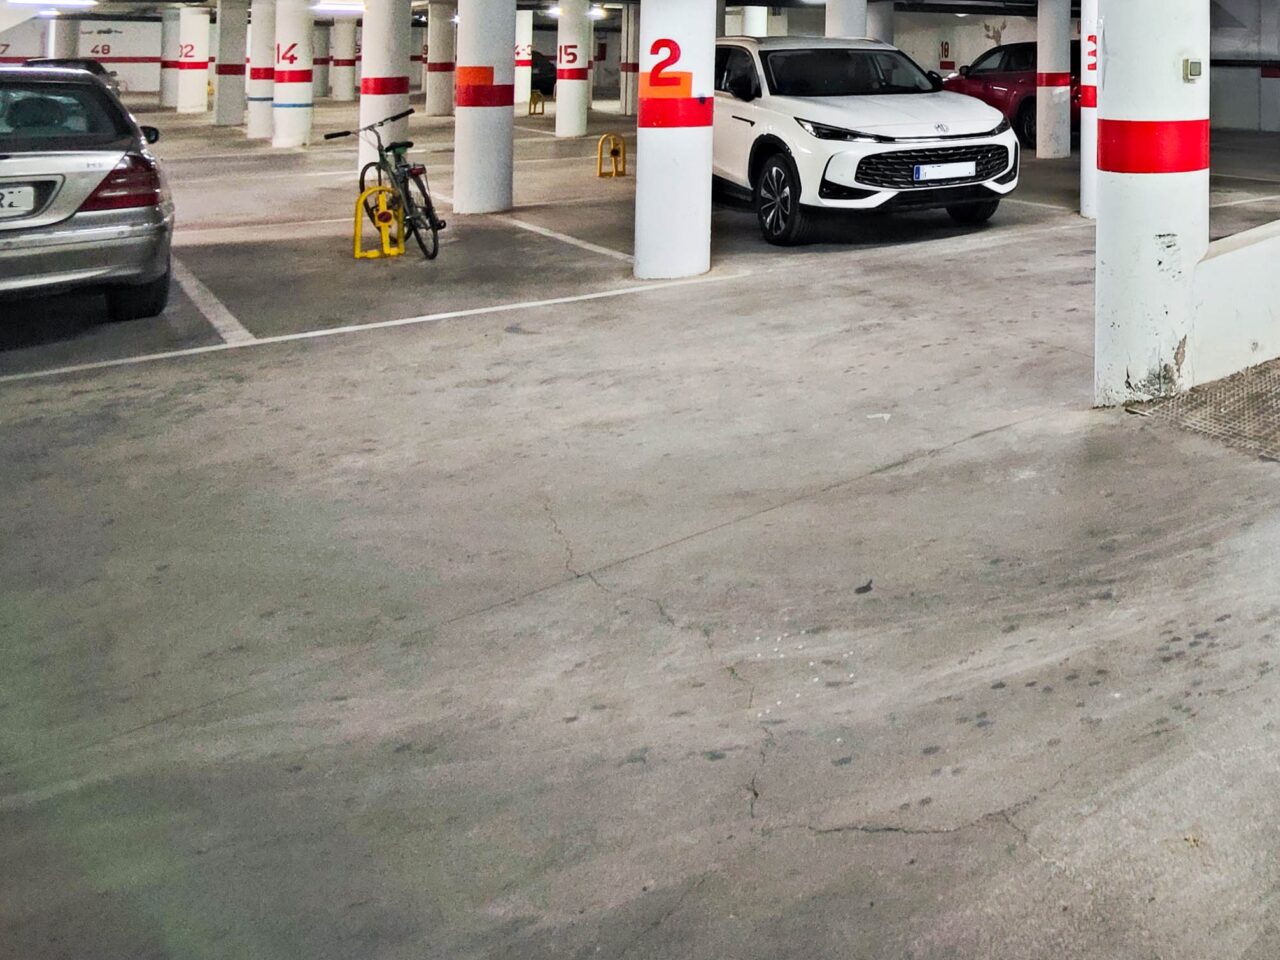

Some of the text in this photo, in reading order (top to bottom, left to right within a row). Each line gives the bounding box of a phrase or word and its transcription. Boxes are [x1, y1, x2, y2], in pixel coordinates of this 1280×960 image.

[91, 44, 110, 55] 48
[276, 43, 298, 64] 14
[559, 45, 578, 64] 15
[650, 39, 681, 87] 2
